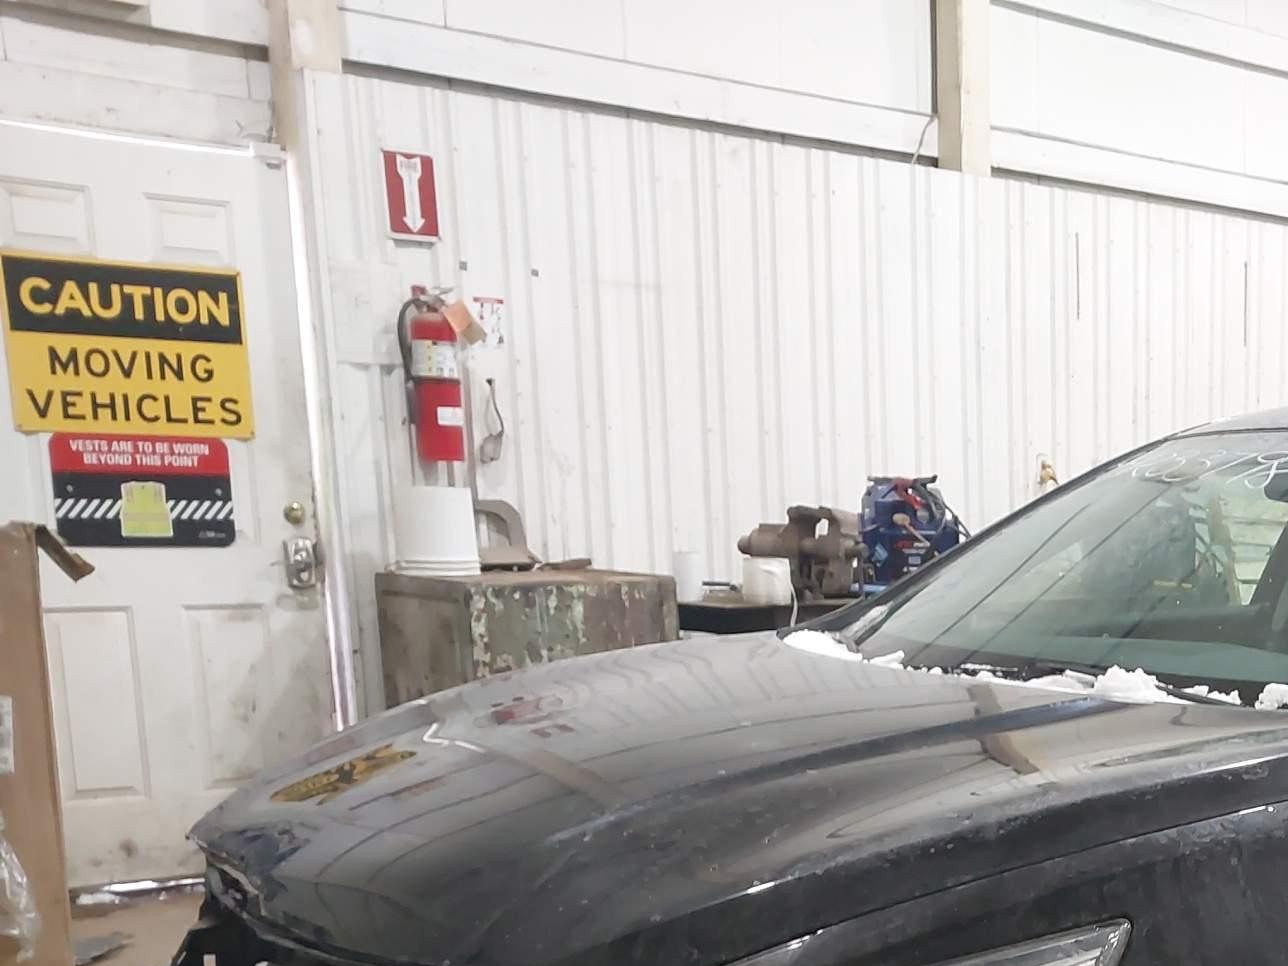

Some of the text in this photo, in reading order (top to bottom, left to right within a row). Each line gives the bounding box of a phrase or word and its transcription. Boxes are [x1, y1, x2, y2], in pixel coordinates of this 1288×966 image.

[19, 276, 230, 327] CAUTION
[48, 345, 215, 383] MOVING
[26, 388, 242, 426] VEHICLES
[69, 439, 209, 456] VESTS ARE TO BE WORN
[83, 453, 199, 468] BEYOND THIS POINT
